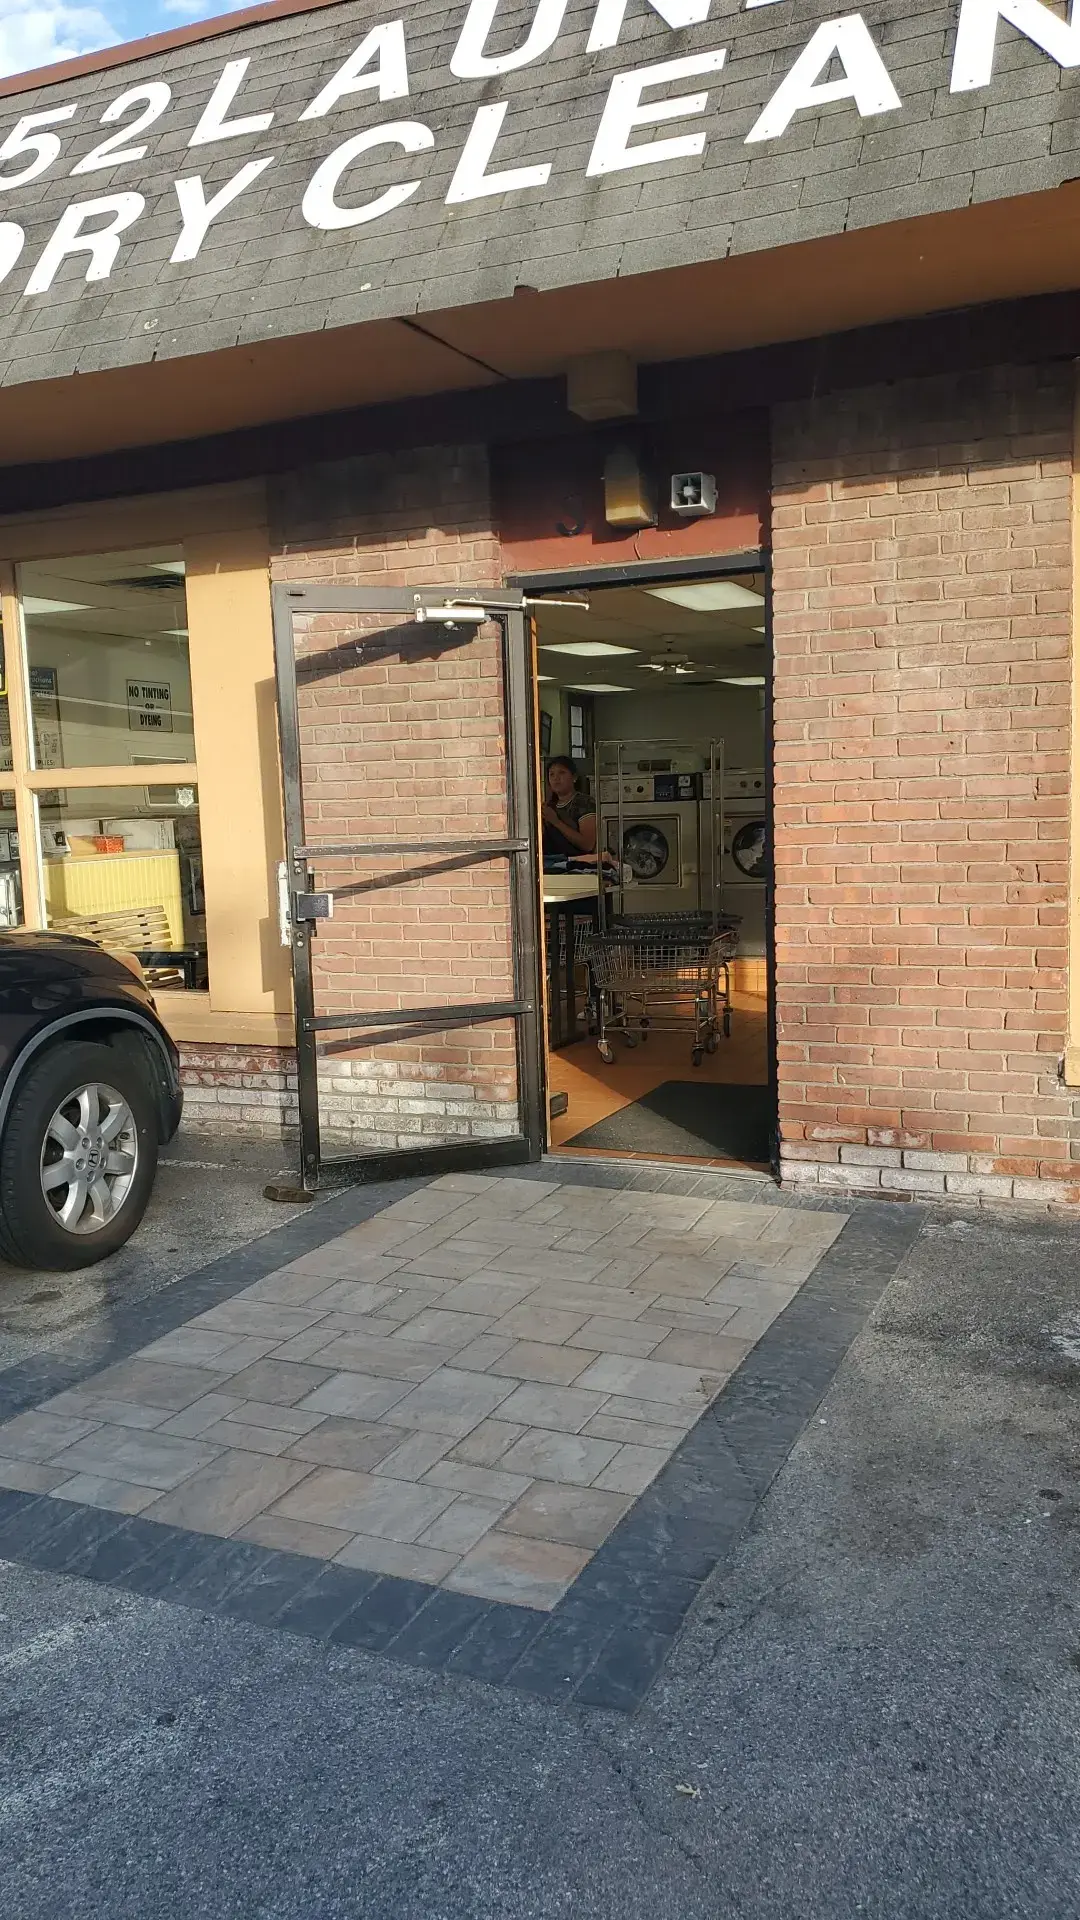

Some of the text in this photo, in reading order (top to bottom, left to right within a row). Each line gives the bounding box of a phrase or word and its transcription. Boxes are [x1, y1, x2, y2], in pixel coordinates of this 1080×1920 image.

[187, 0, 787, 147] LAUN
[128, 685, 169, 700] NO TINTING
[144, 702, 155, 710] OR
[139, 714, 162, 727] DYEING
